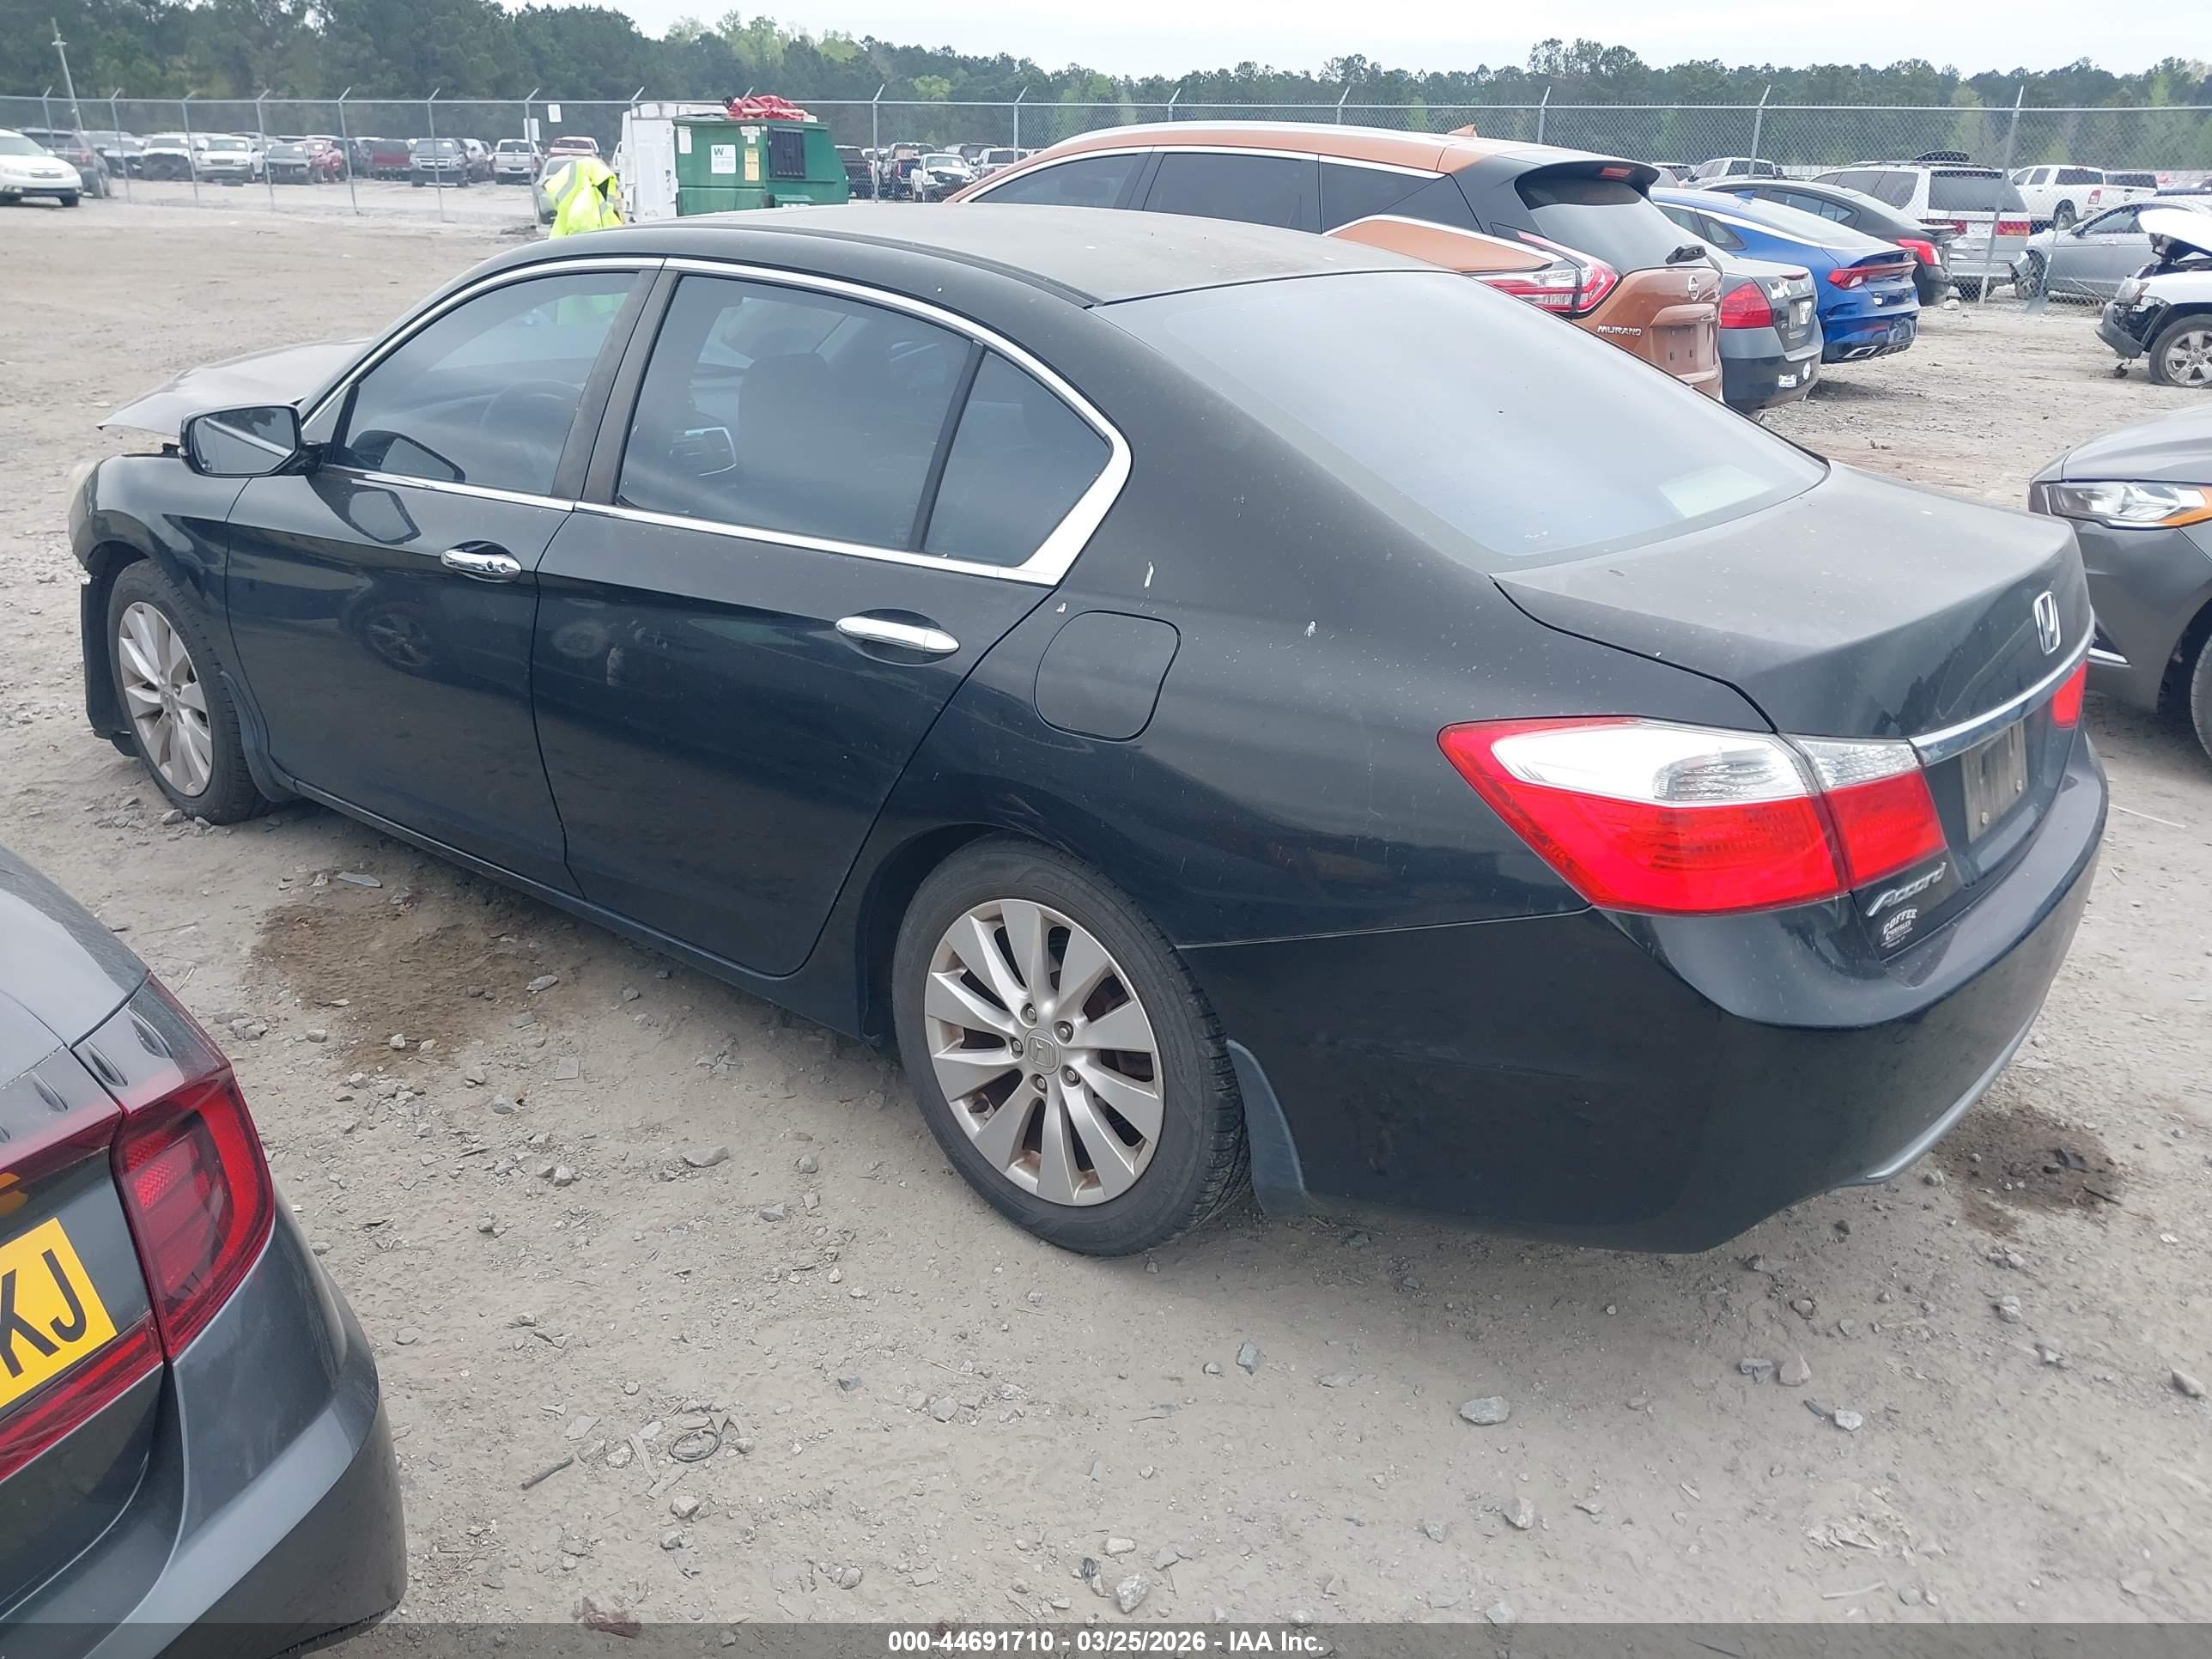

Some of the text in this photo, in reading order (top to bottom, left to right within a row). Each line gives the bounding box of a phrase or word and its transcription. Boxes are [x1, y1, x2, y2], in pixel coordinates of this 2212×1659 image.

[1597, 325, 1642, 337] MURANO
[1865, 862, 1947, 916] Accord
[1883, 908, 1917, 935] COFFEE
